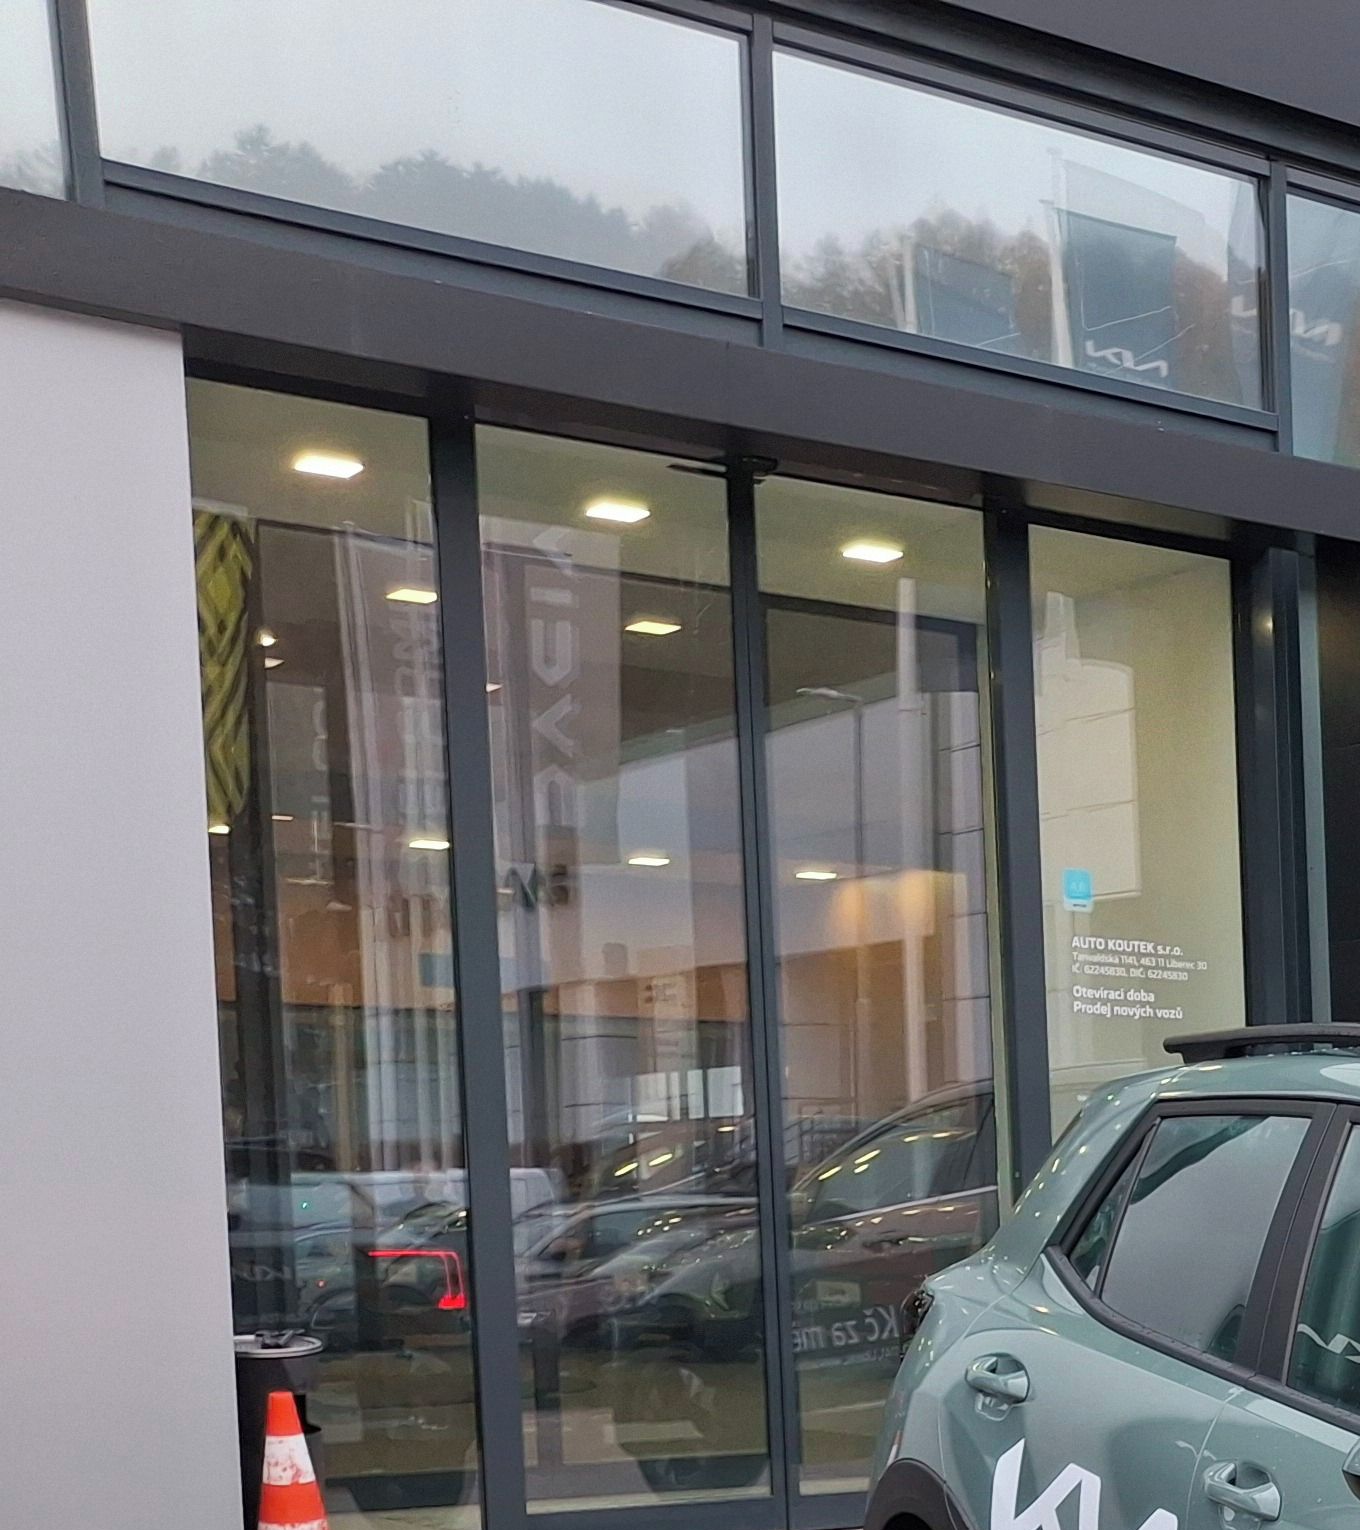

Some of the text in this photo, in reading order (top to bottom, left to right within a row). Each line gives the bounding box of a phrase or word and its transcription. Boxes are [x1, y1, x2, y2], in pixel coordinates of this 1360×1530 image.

[1072, 936, 1184, 956] AUTO KOUTEK s.r.o.
[1197, 960, 1208, 970] 30
[1126, 989, 1155, 1002] doba
[1073, 1001, 1183, 1019] Prodej nových vozů
